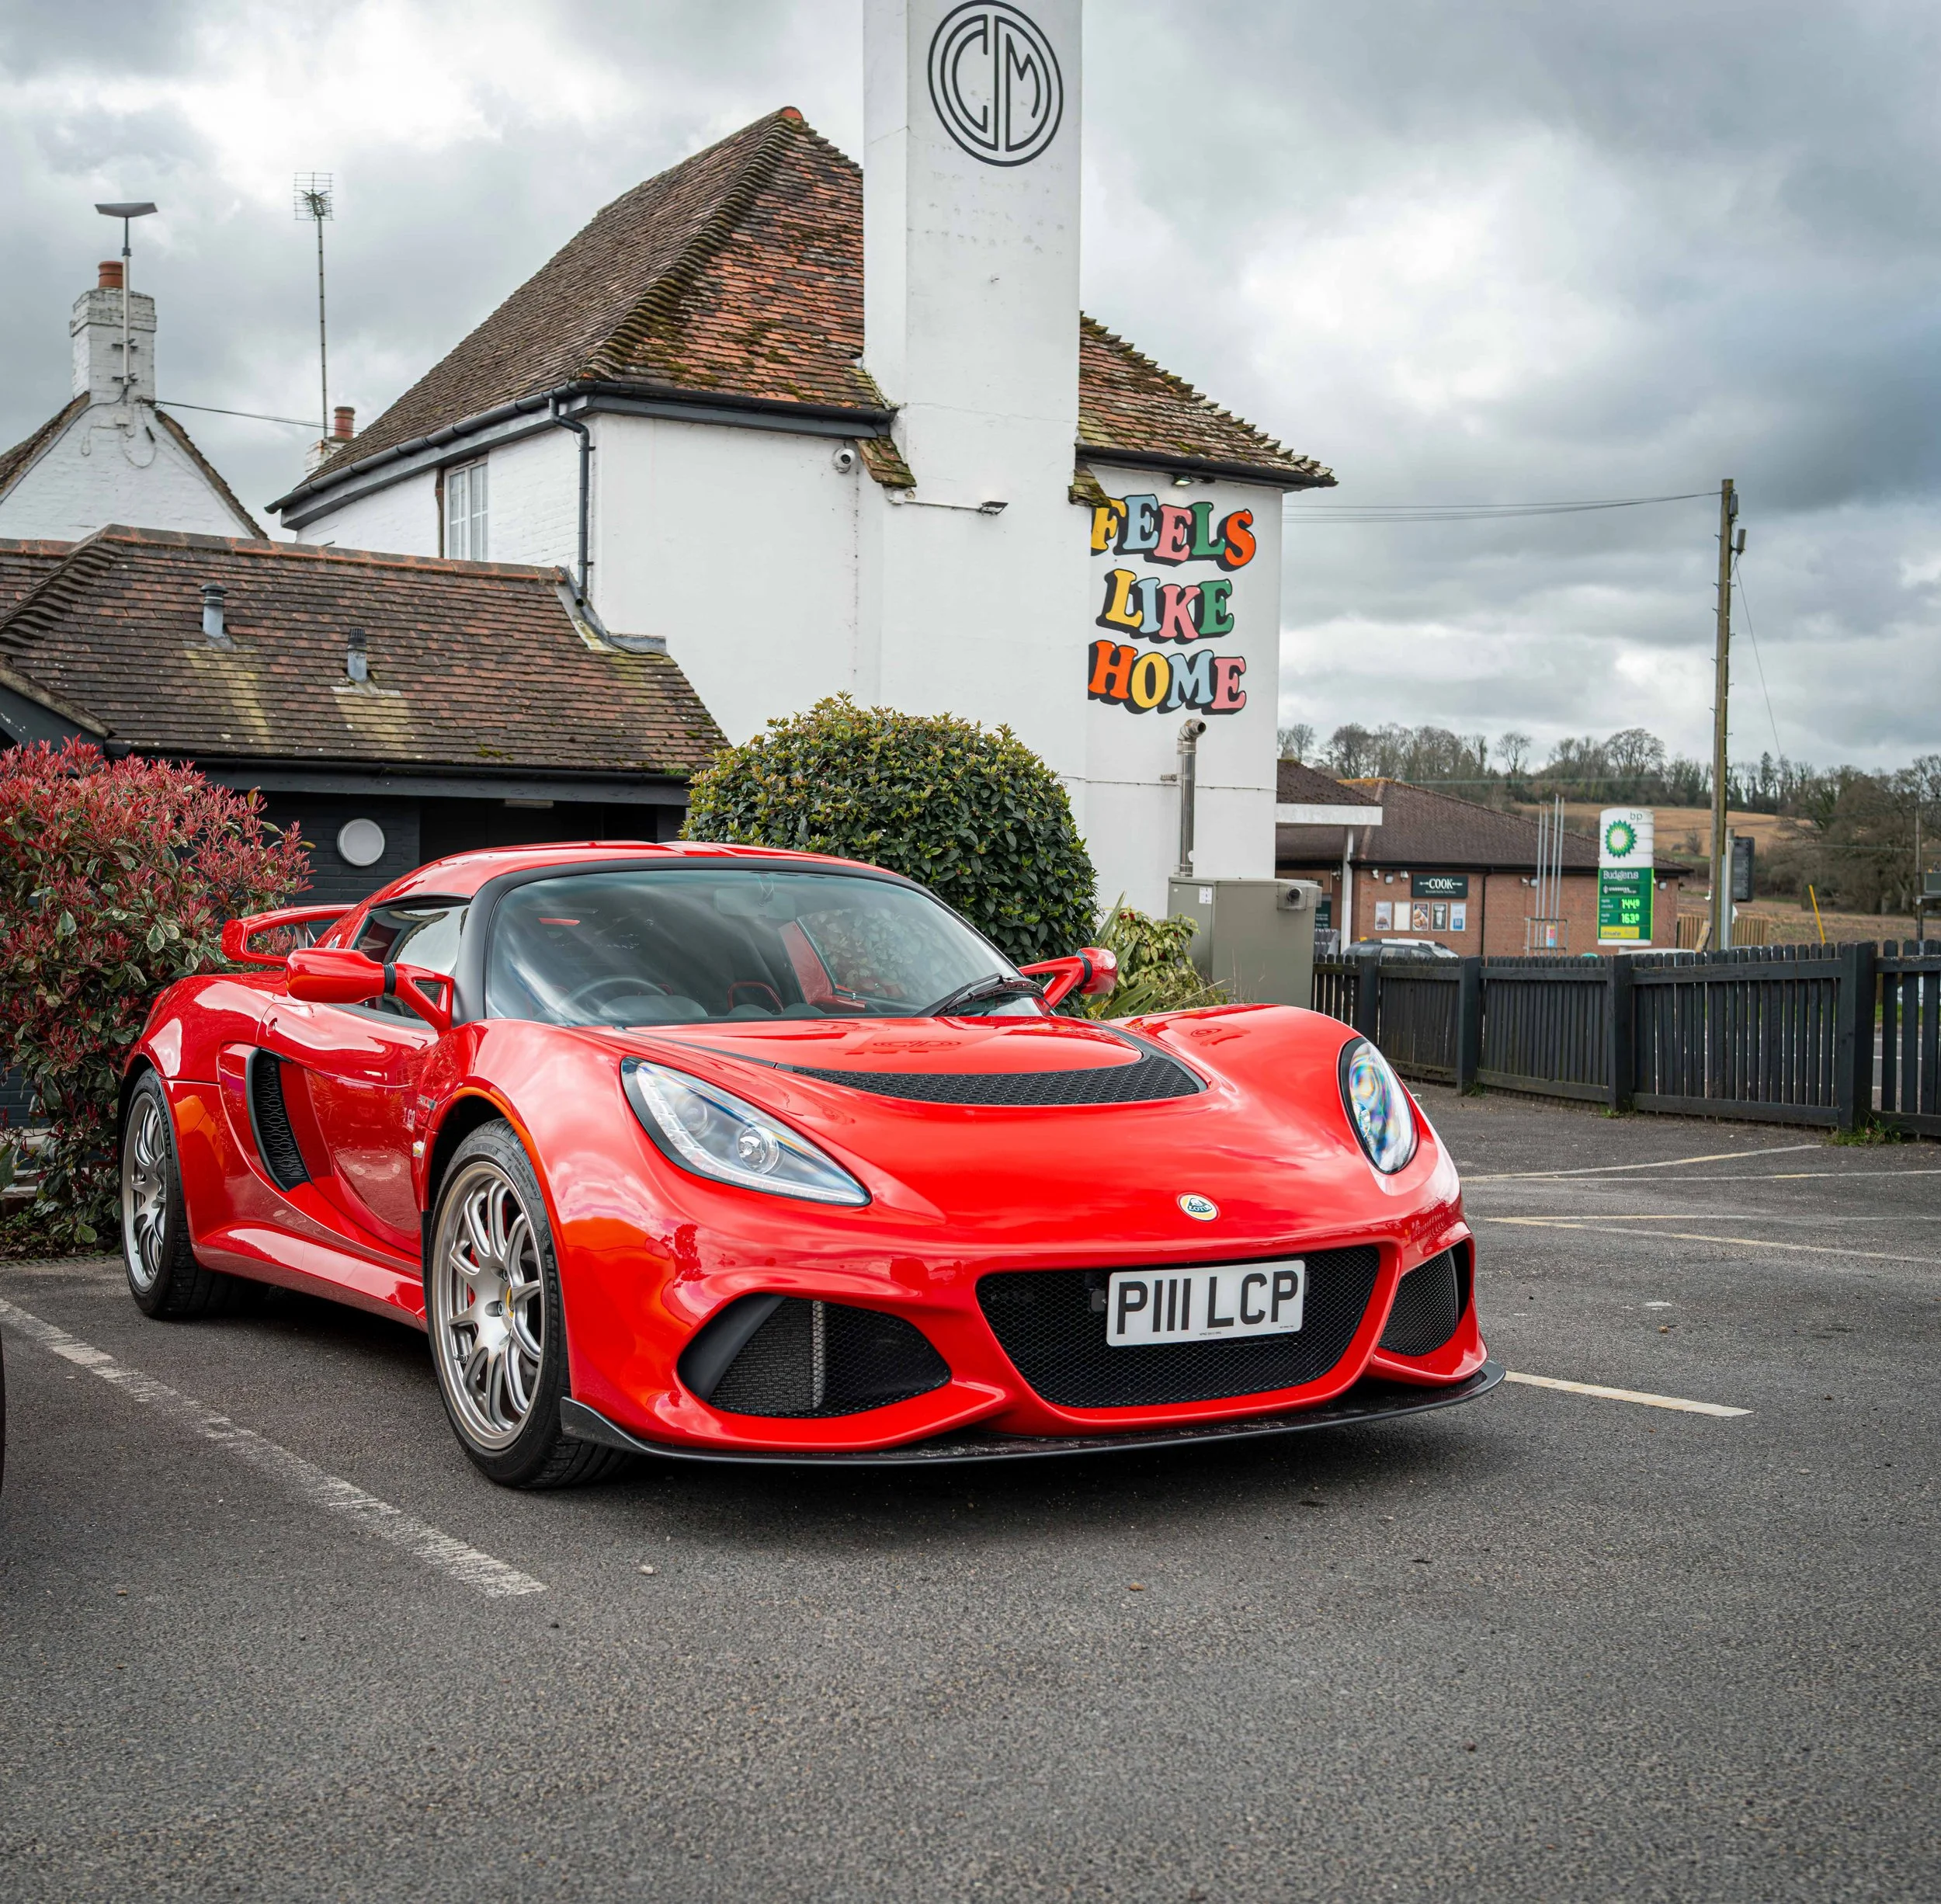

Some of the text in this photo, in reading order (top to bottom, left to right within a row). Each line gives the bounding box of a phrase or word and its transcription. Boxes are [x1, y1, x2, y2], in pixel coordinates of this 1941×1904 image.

[1091, 493, 1257, 572] FEELS
[1096, 568, 1234, 645] LIKE
[1088, 639, 1247, 715] HOME
[1630, 812, 1643, 822] bp
[1429, 878, 1453, 890] COOK
[1603, 870, 1639, 881] Budgens
[546, 1254, 560, 1350] MICHELIN
[1207, 1270, 1299, 1329] LCP
